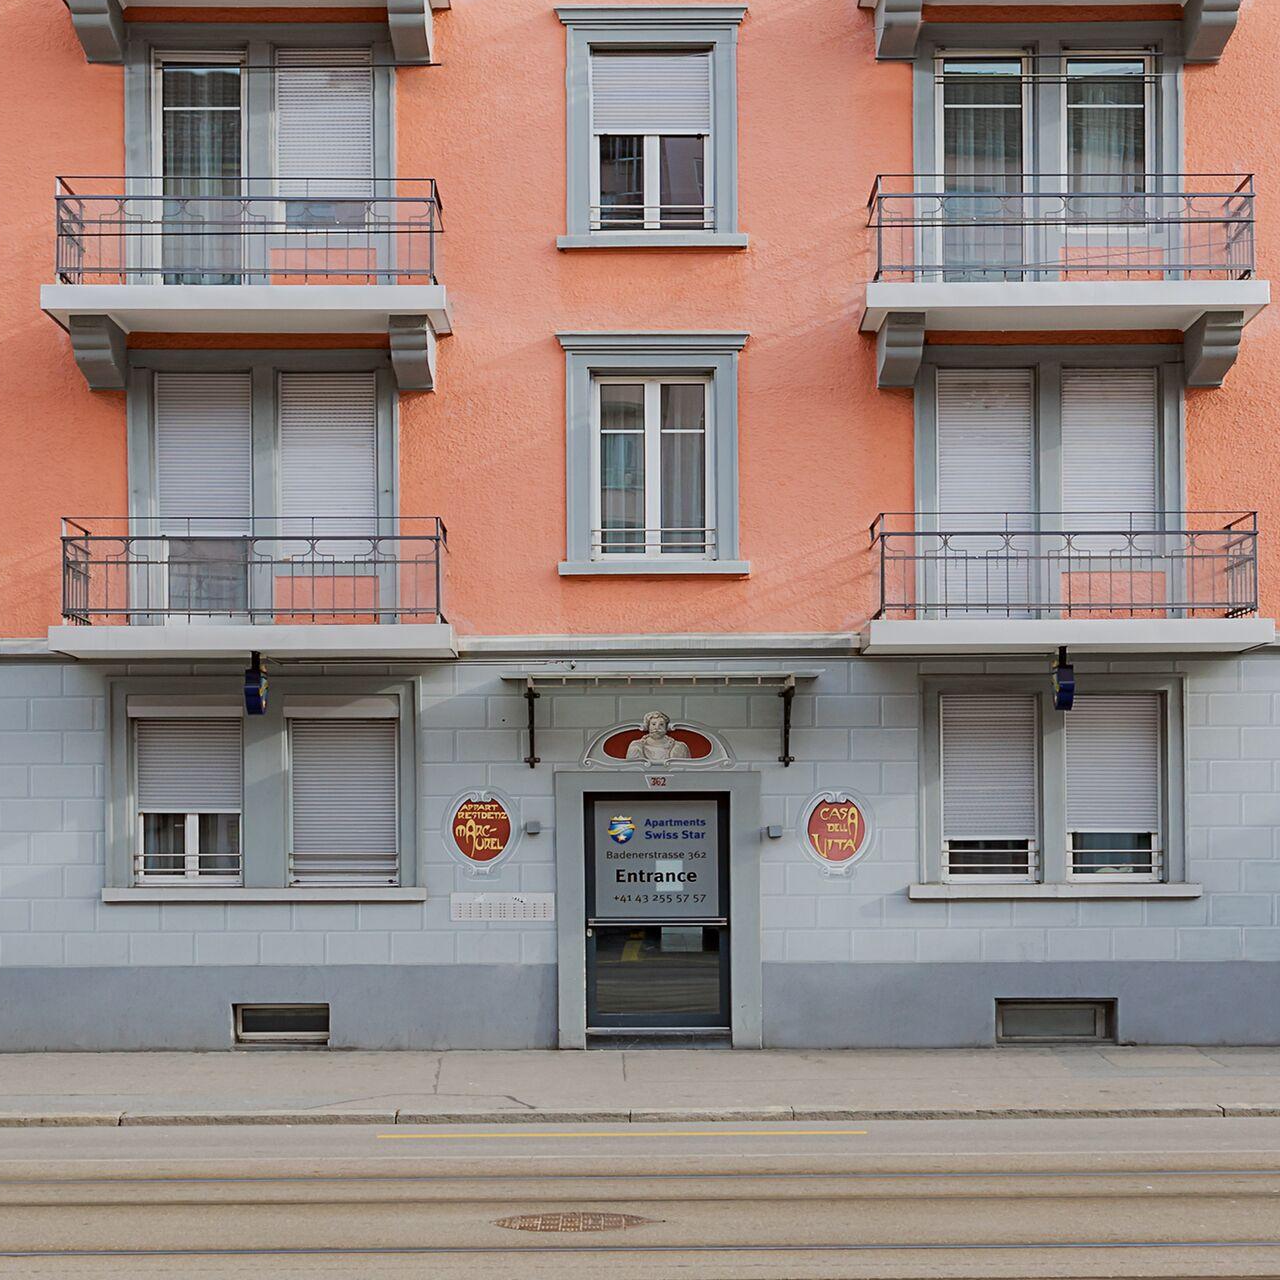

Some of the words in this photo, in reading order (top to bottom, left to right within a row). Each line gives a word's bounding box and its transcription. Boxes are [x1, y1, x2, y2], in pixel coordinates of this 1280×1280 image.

[650, 776, 666, 787] 362
[460, 804, 498, 812] APPART
[644, 819, 706, 829] Apartments
[644, 830, 679, 840] Swiss
[681, 830, 706, 840] Star
[606, 850, 685, 860] Badenerstrasse
[688, 851, 707, 861] 362
[615, 869, 697, 883] Entrance
[614, 894, 631, 904] +41
[635, 894, 648, 904] 43
[652, 894, 672, 904] 255
[676, 894, 689, 904] 57
[693, 894, 707, 904] 57
